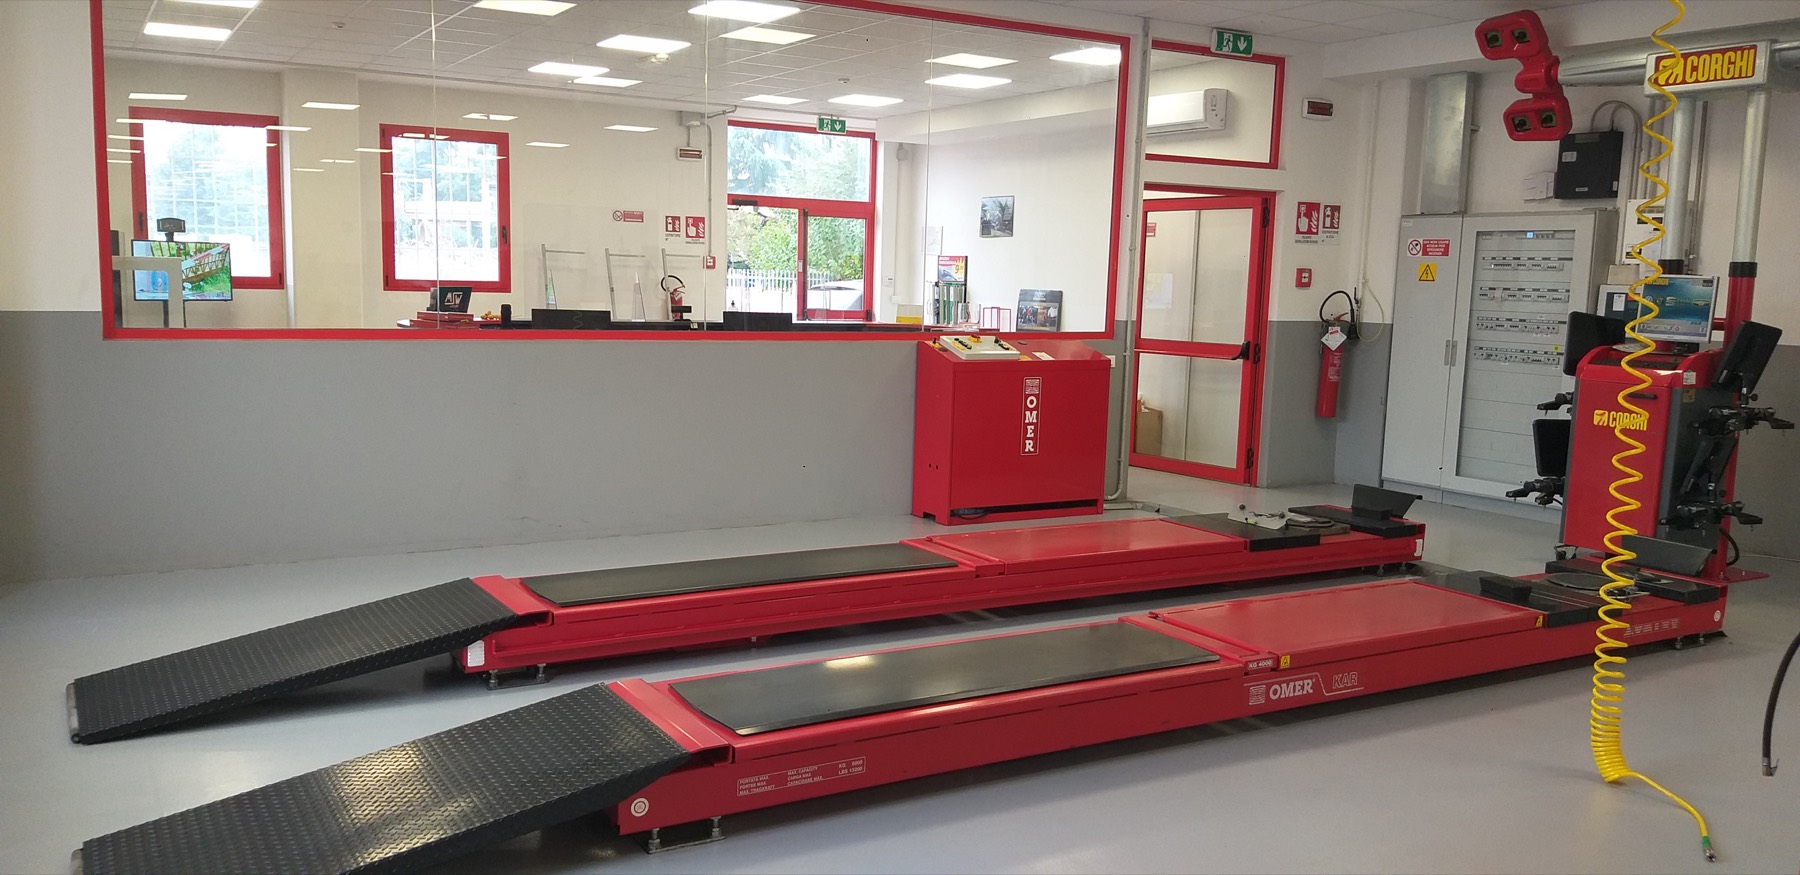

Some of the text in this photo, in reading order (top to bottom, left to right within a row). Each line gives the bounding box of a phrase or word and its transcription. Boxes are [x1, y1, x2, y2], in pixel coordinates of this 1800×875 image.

[1685, 49, 1755, 83] CORGHI
[1024, 395, 1037, 452] OMER
[1609, 411, 1648, 431] CORGHI
[1269, 671, 1358, 700] OMER KAR
